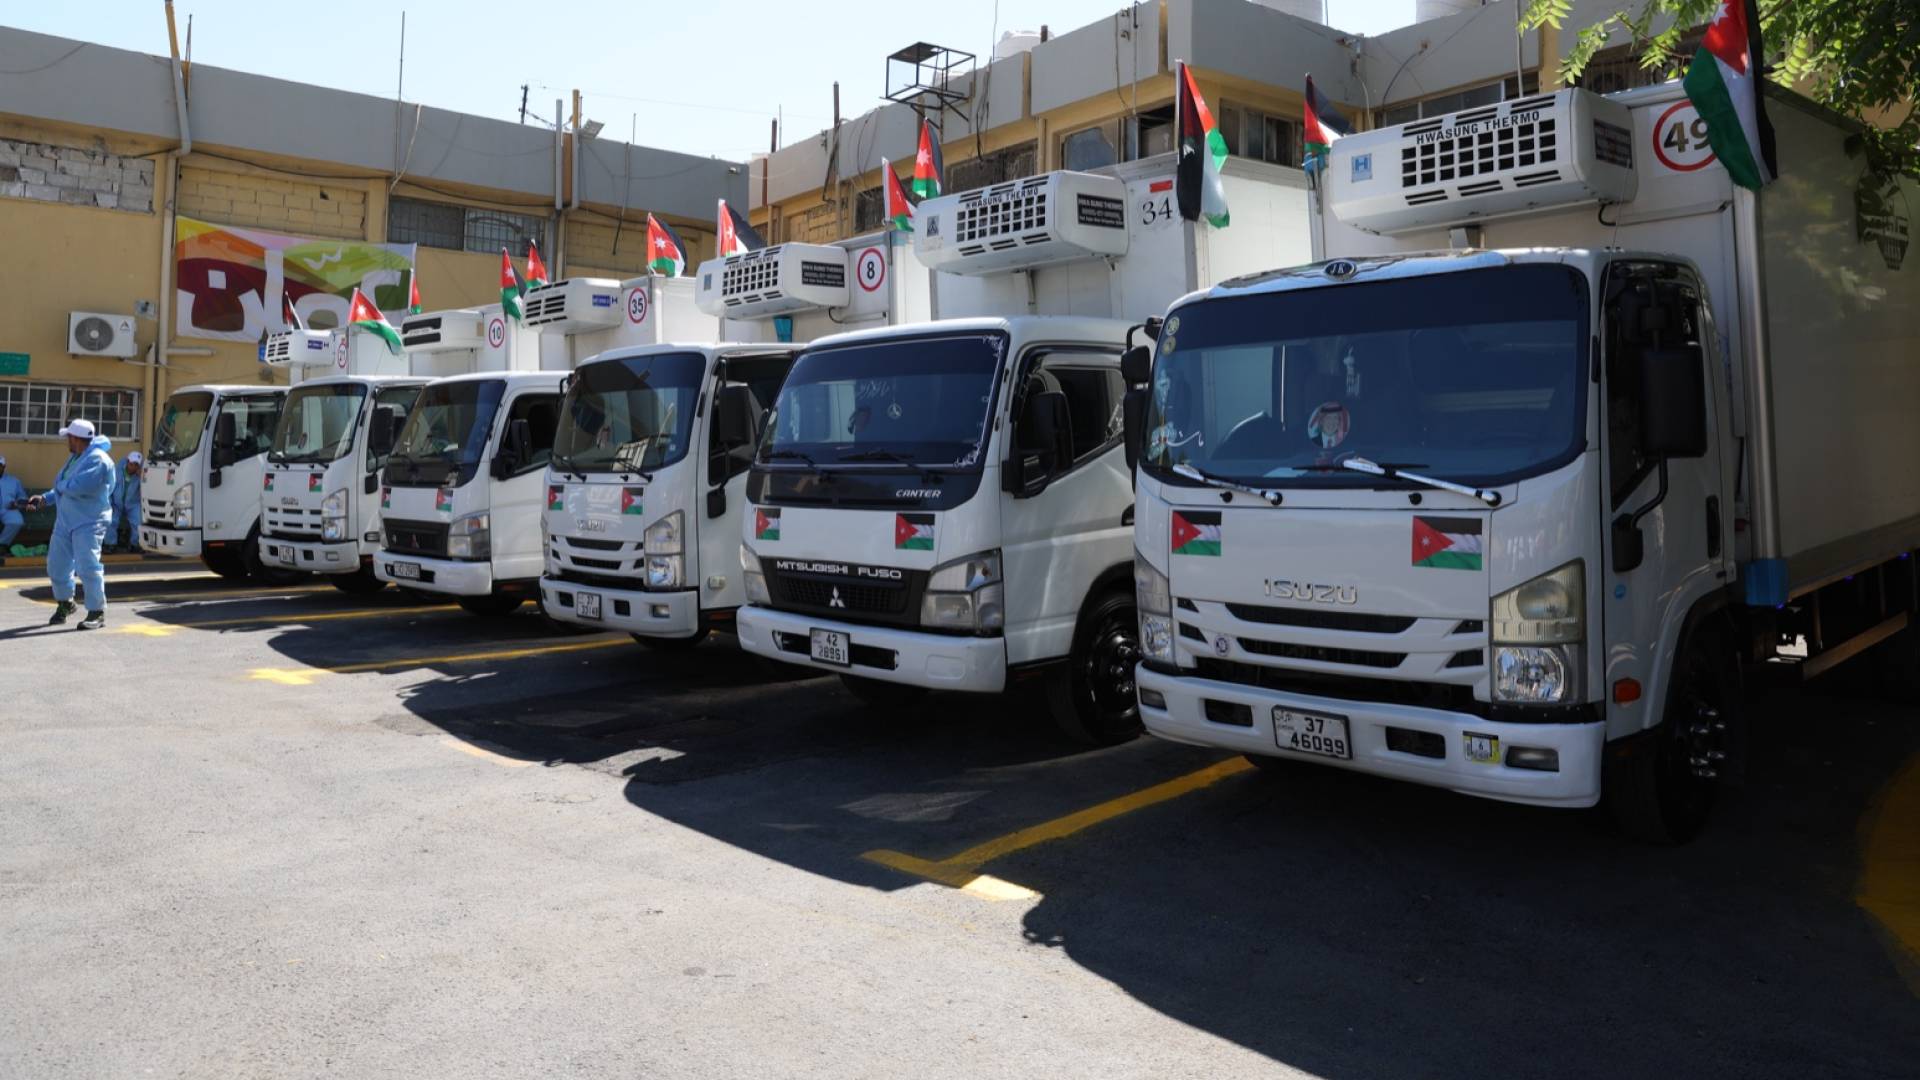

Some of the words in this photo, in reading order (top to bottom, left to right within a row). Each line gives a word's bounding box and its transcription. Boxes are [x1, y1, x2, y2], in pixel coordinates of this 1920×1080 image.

[1416, 123, 1479, 145] HWASUNG
[1484, 111, 1540, 132] THERMO
[1664, 117, 1710, 153] 49
[1006, 187, 1039, 201] THERMO
[1142, 196, 1173, 225] 34
[866, 261, 875, 280] 8
[631, 298, 644, 314] 35
[491, 326, 502, 341] 10
[896, 489, 942, 498] CANTER
[777, 560, 849, 575] MITSUBISHI
[858, 567, 902, 579] FUSO
[1264, 578, 1357, 605] ISUZU
[826, 632, 839, 647] 42
[1304, 716, 1324, 734] 37
[1291, 732, 1345, 755] 46099
